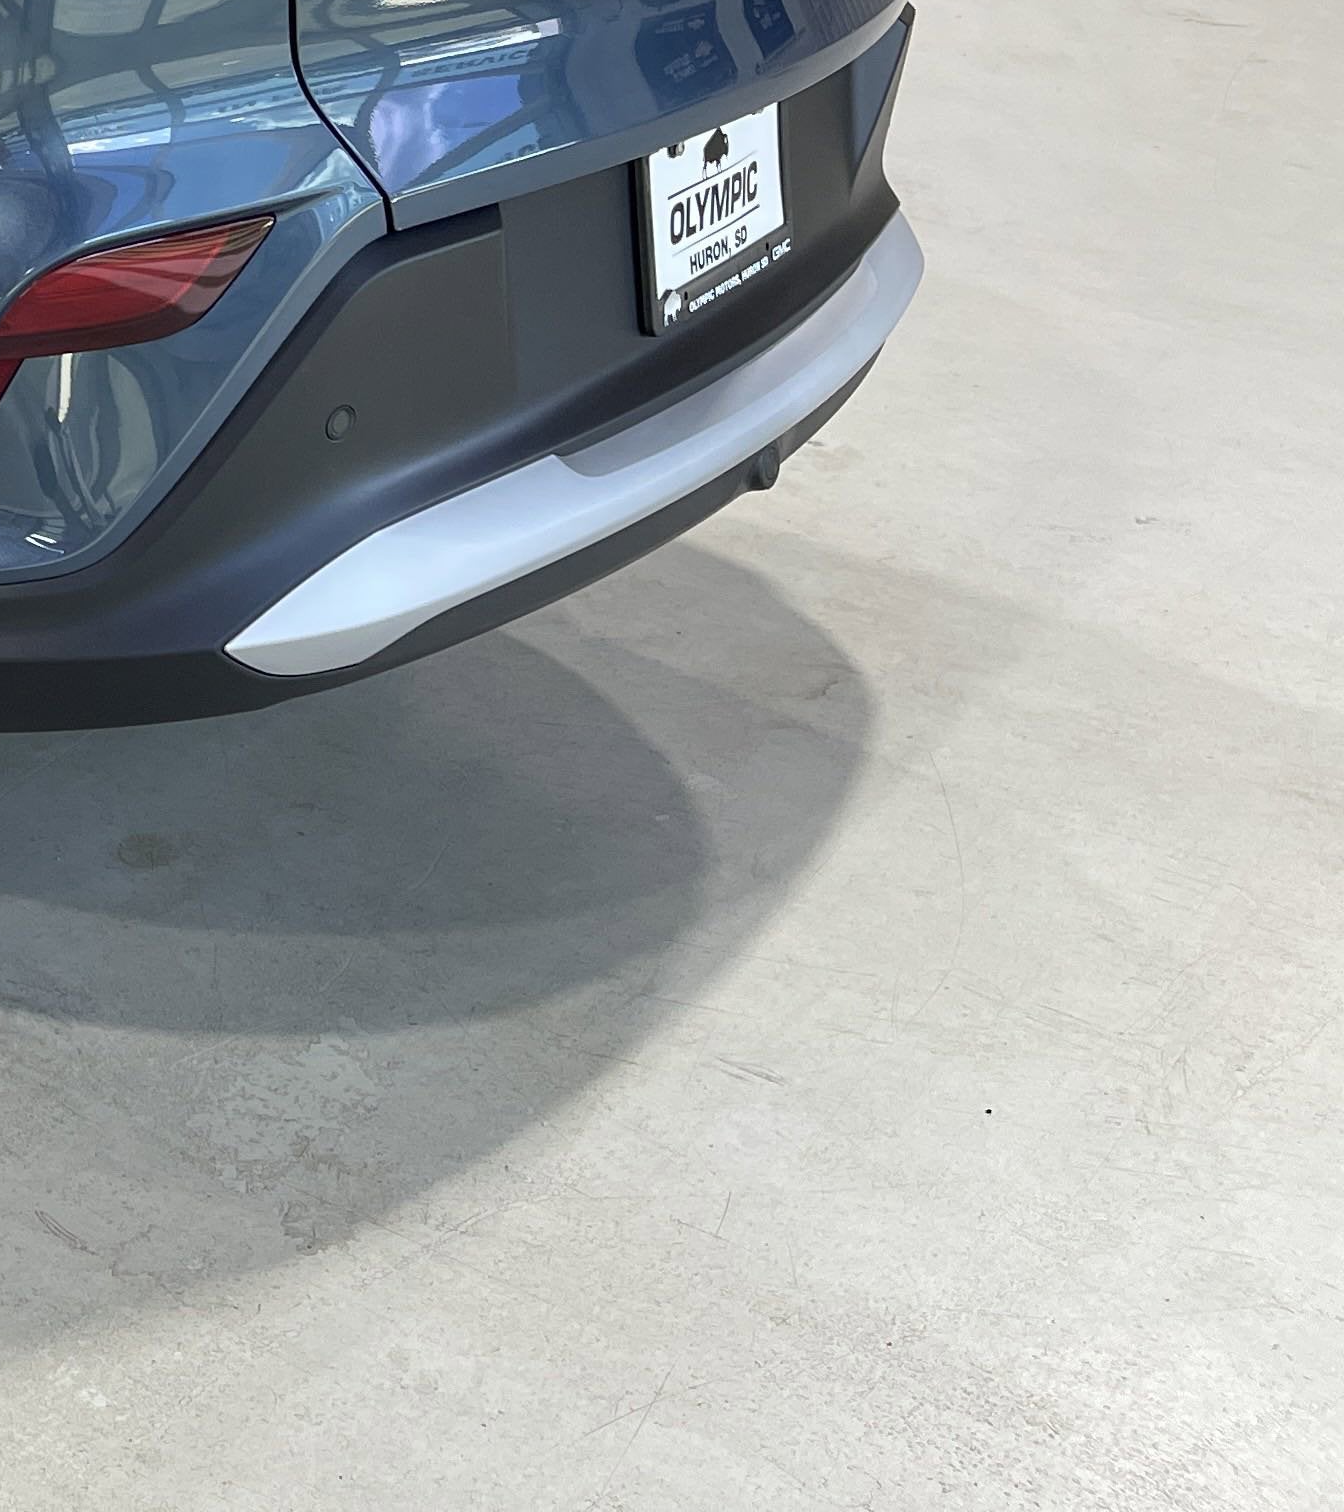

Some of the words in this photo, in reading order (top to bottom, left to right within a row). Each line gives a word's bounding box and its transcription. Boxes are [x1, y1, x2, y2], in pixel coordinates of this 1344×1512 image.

[670, 161, 758, 245] OLYMPIC
[690, 235, 732, 275] HURON,
[734, 225, 748, 248] SD
